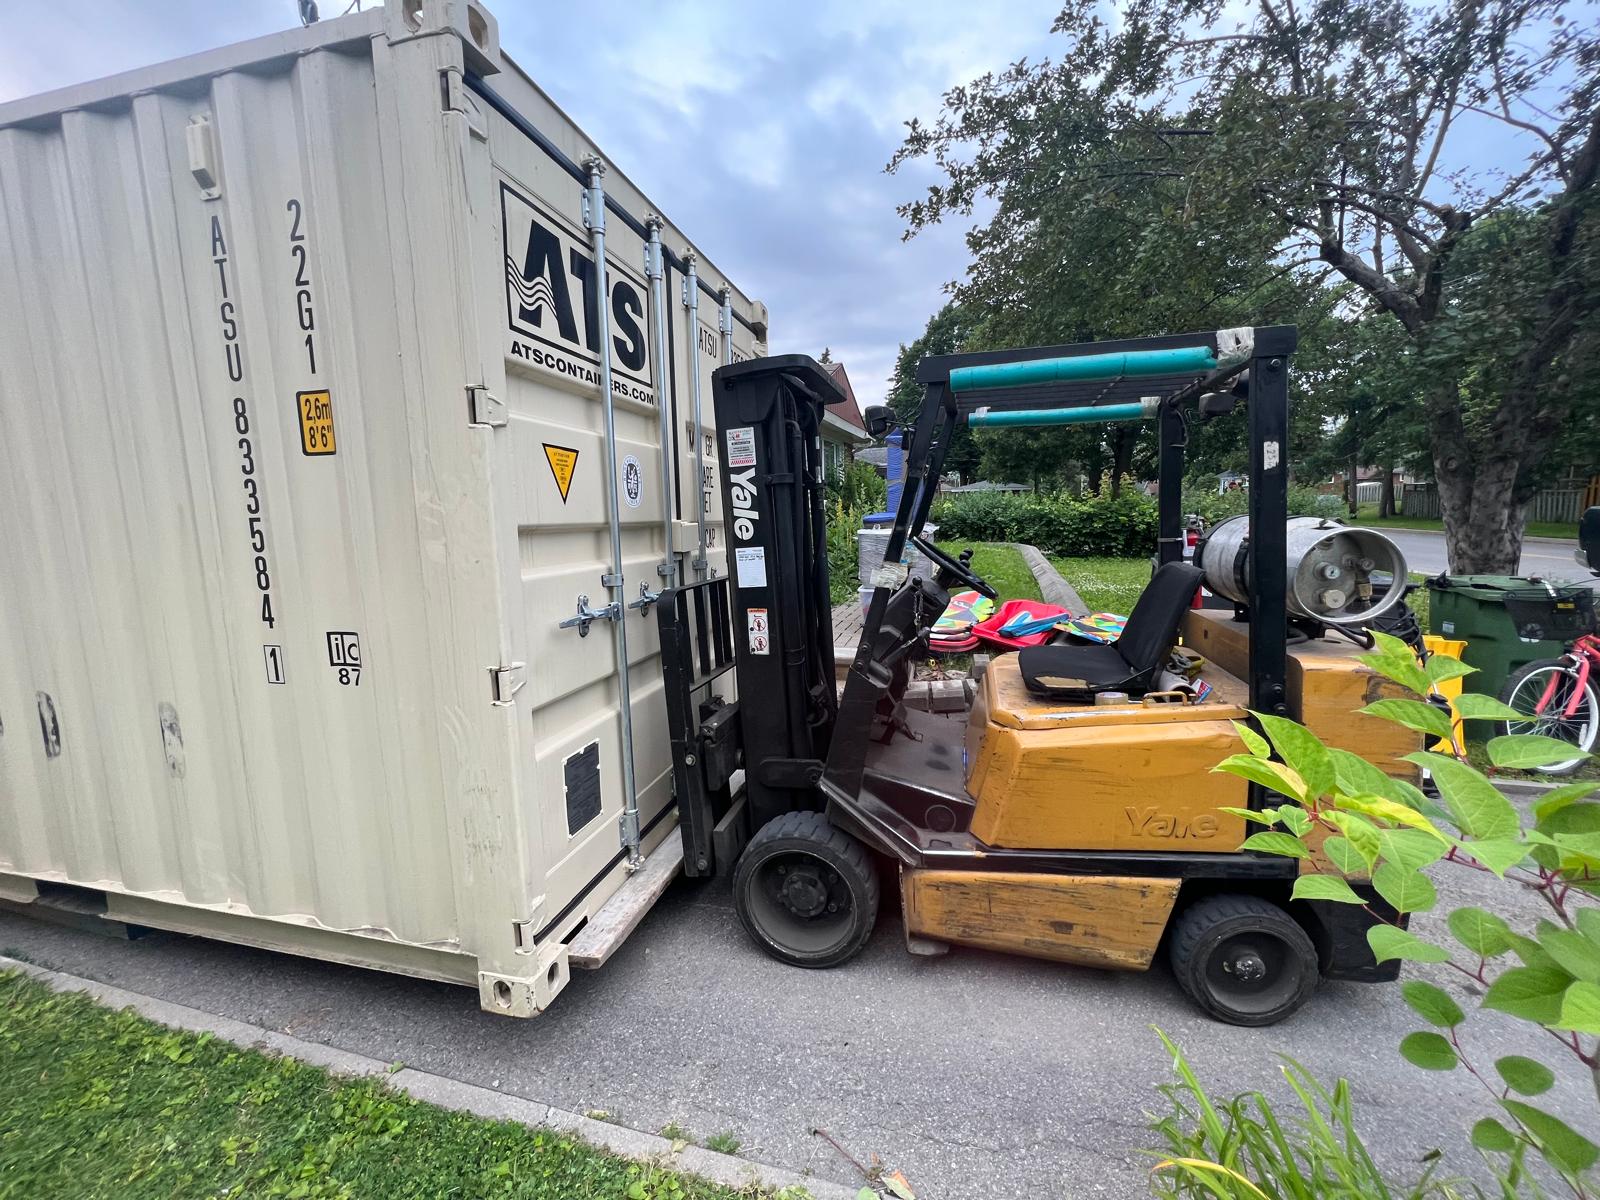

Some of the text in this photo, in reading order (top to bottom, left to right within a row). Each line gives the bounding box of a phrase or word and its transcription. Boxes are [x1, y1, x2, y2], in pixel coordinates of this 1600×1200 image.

[286, 199, 318, 375] 22G1
[518, 218, 646, 372] ATS
[698, 326, 718, 359] ATSU
[510, 340, 655, 406] ATSCONTAIRS.COM
[210, 214, 244, 383] ATSU
[233, 397, 275, 630] 833584
[703, 466, 714, 489] ARE
[704, 491, 712, 513] ET
[729, 467, 760, 542] Yale
[338, 667, 361, 687] 87
[1123, 805, 1218, 839] Yale
